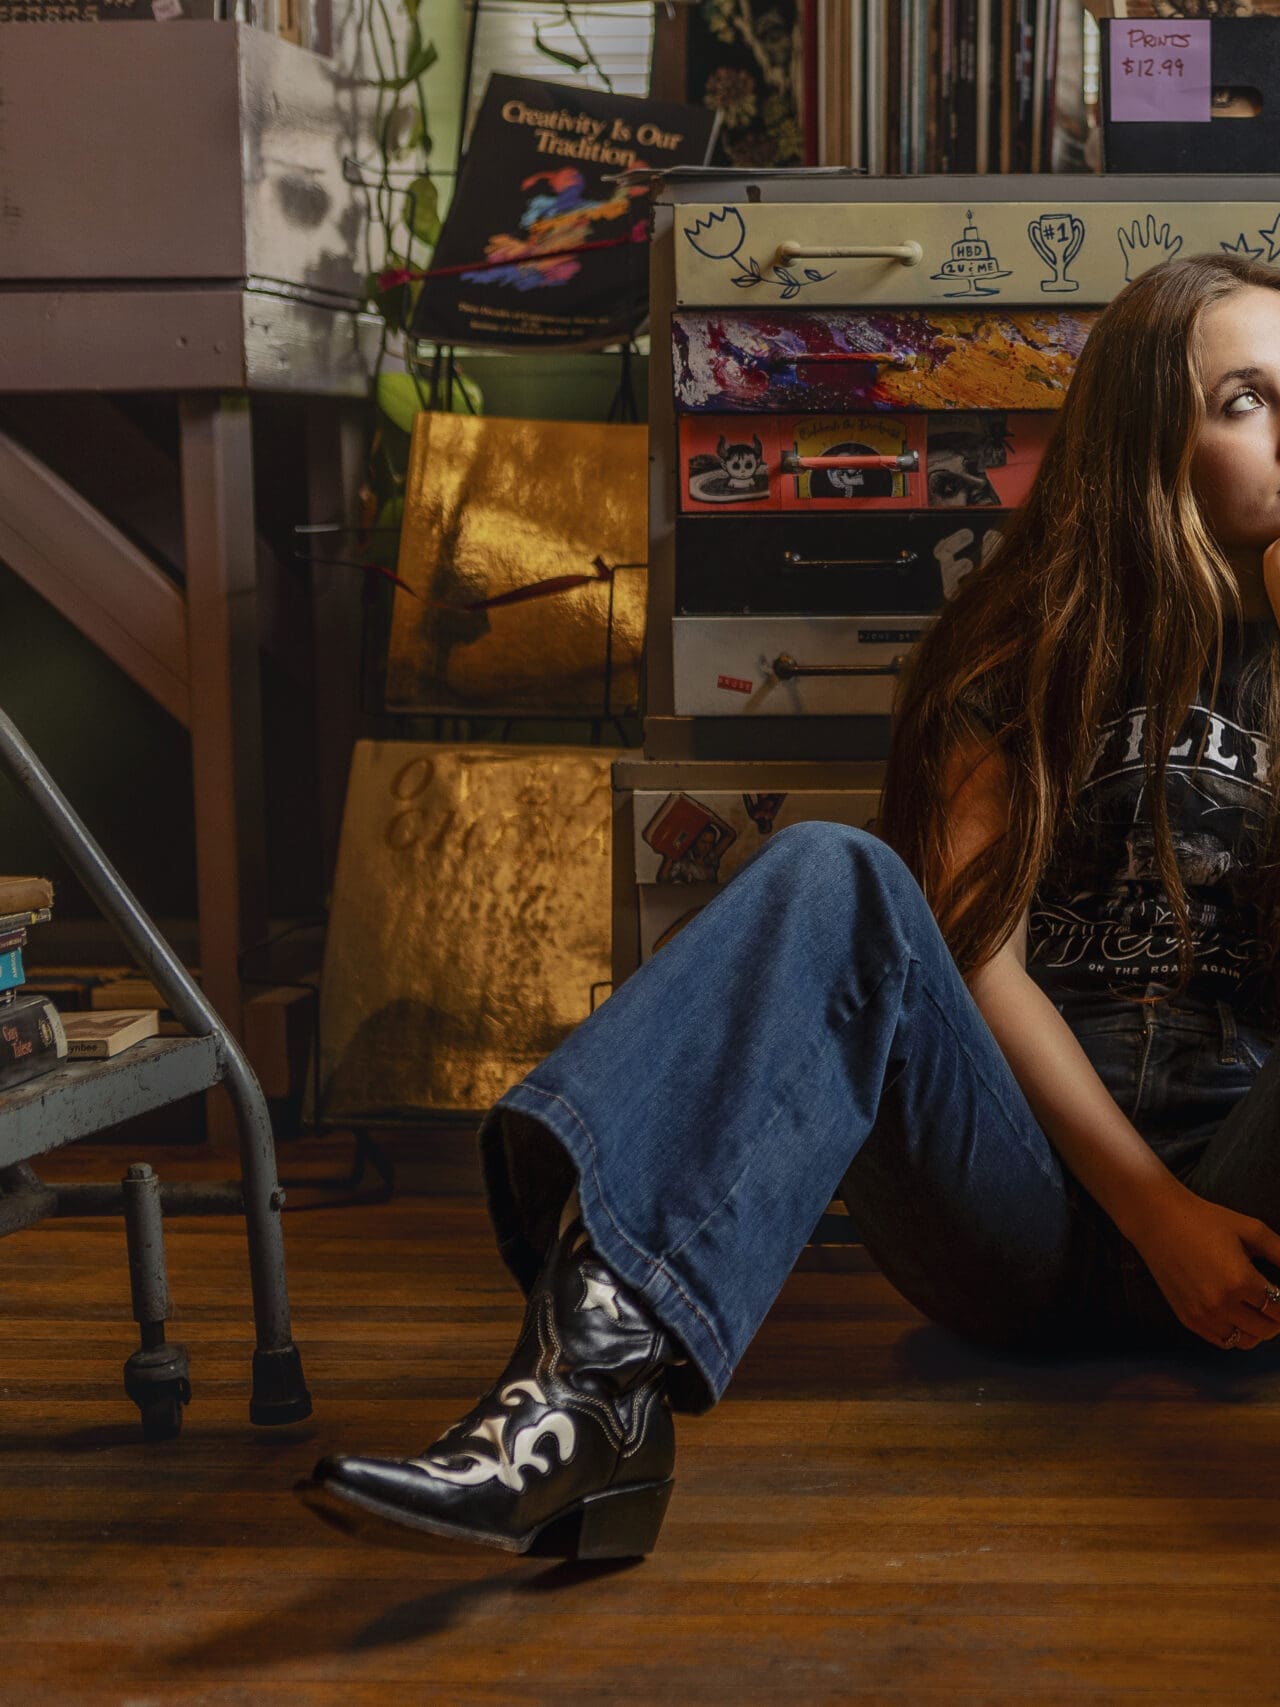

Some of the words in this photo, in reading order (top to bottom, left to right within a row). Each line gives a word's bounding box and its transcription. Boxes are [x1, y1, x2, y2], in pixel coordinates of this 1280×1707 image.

[1127, 29, 1191, 49] PRINTS
[1121, 57, 1185, 77] $12.99
[501, 99, 608, 144] Creativity
[611, 117, 633, 143] Is
[636, 122, 685, 152] Our
[534, 128, 638, 168] Tradition
[1042, 223, 1069, 243] #1
[957, 245, 983, 258] HBD
[1088, 962, 1105, 973] ON
[1114, 966, 1140, 975] THE
[1150, 964, 1187, 974] ROA
[1200, 963, 1241, 979] AGAIN
[2, 1024, 19, 1043] Gay
[12, 1040, 33, 1058] Talese
[68, 1044, 97, 1054] ynbee
